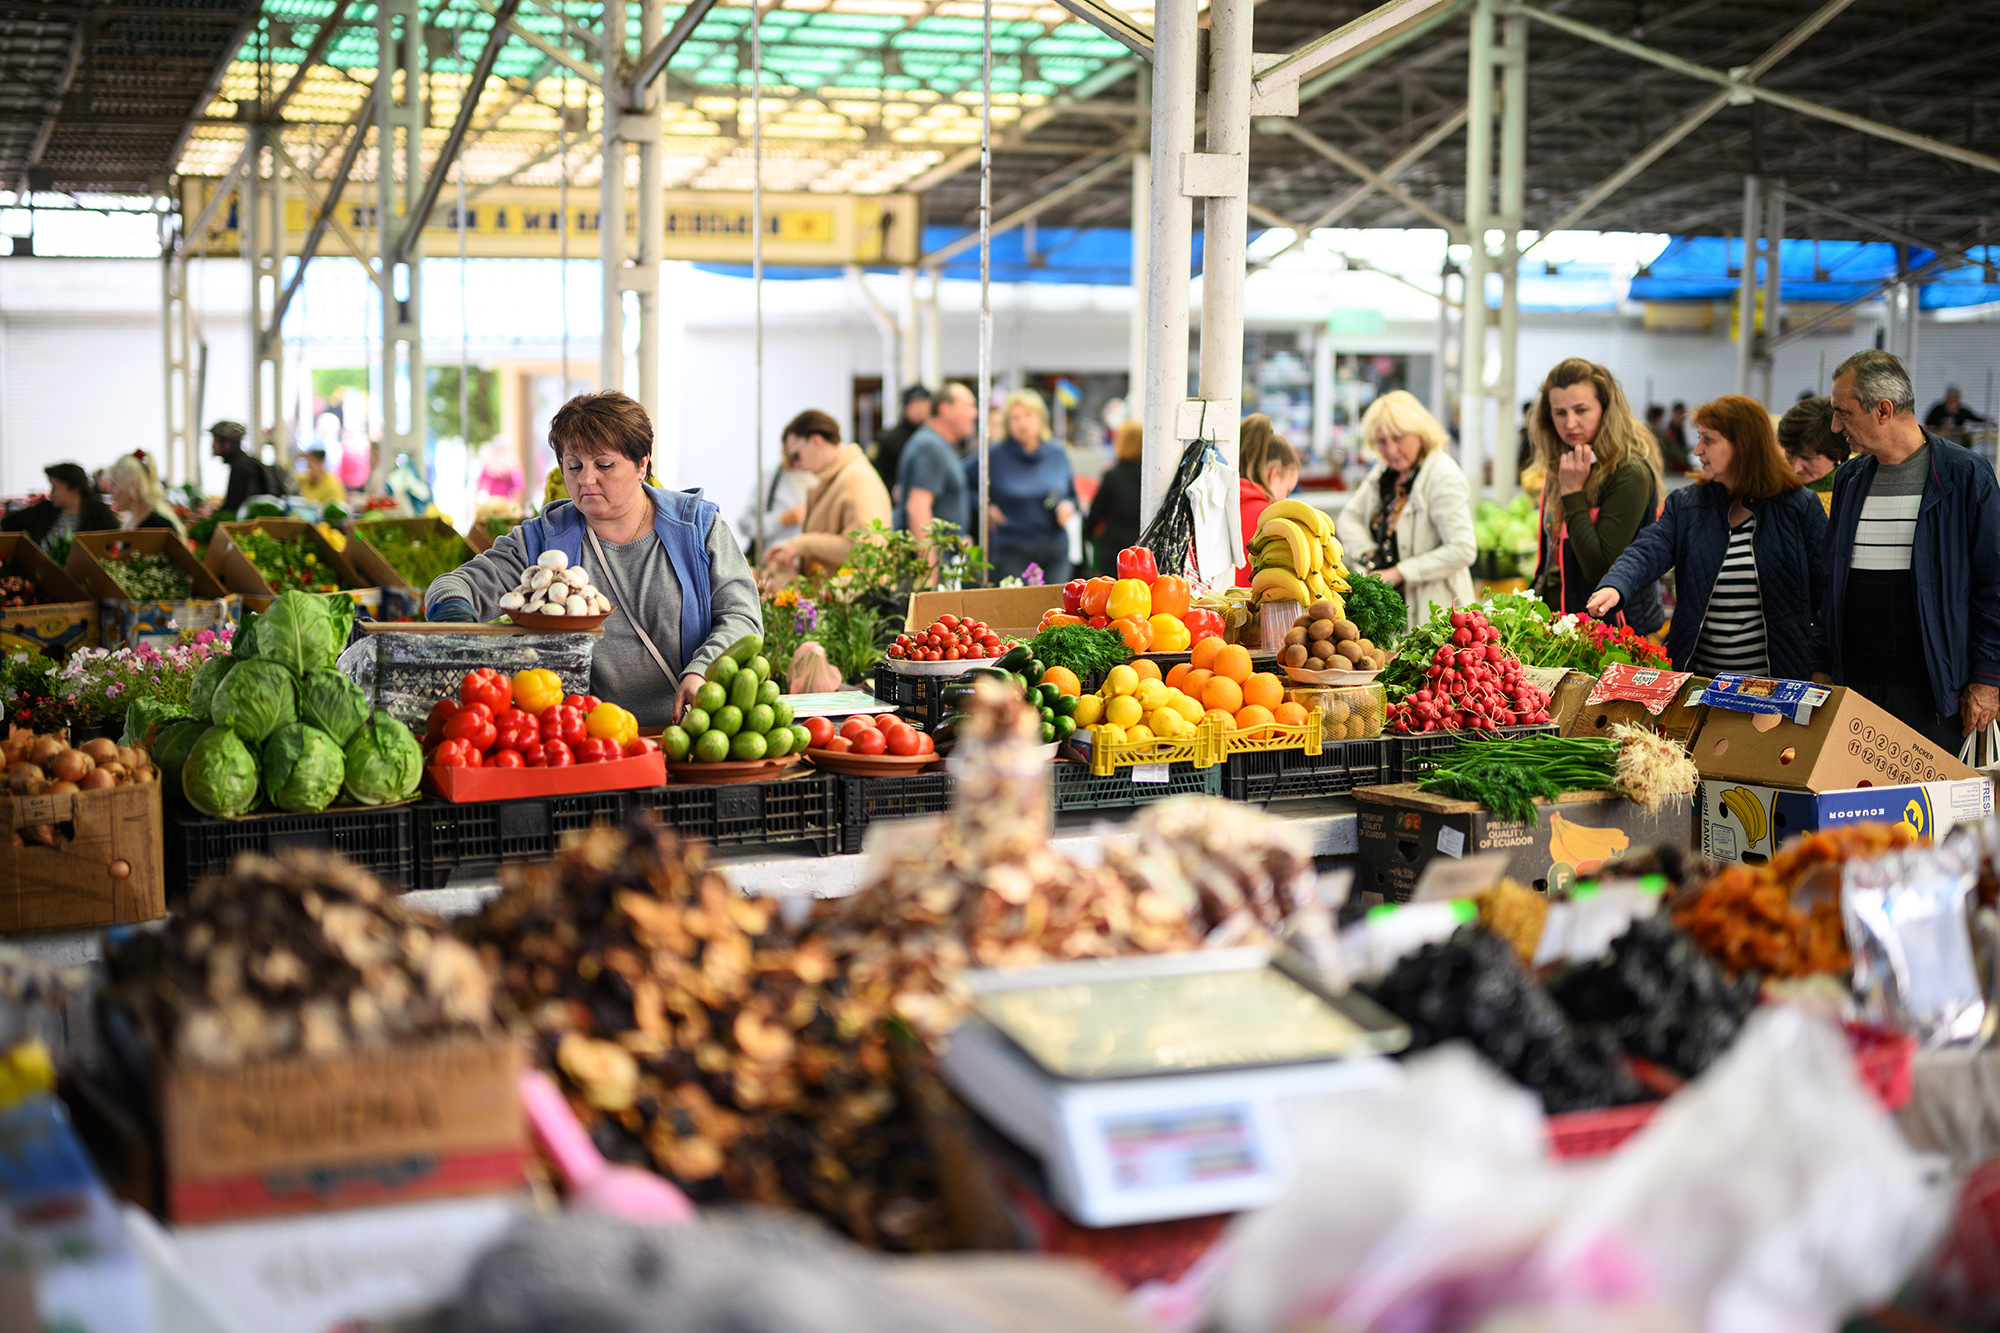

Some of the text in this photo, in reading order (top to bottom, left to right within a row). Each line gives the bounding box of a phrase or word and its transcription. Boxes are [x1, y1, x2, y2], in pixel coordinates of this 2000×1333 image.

[1912, 743, 1934, 762] PACKER
[1851, 742, 1860, 753] 11
[1863, 750, 1874, 760] 12
[1876, 758, 1885, 769] 13
[1888, 766, 1898, 777] 14
[1982, 780, 1991, 818] FRESH
[1829, 808, 1885, 819] ECUADOR
[1362, 821, 1383, 831] QUALITY
[1365, 829, 1387, 839] ECUADOR
[1488, 829, 1524, 839] QUALITY
[1479, 836, 1534, 849] OF ECUADOR
